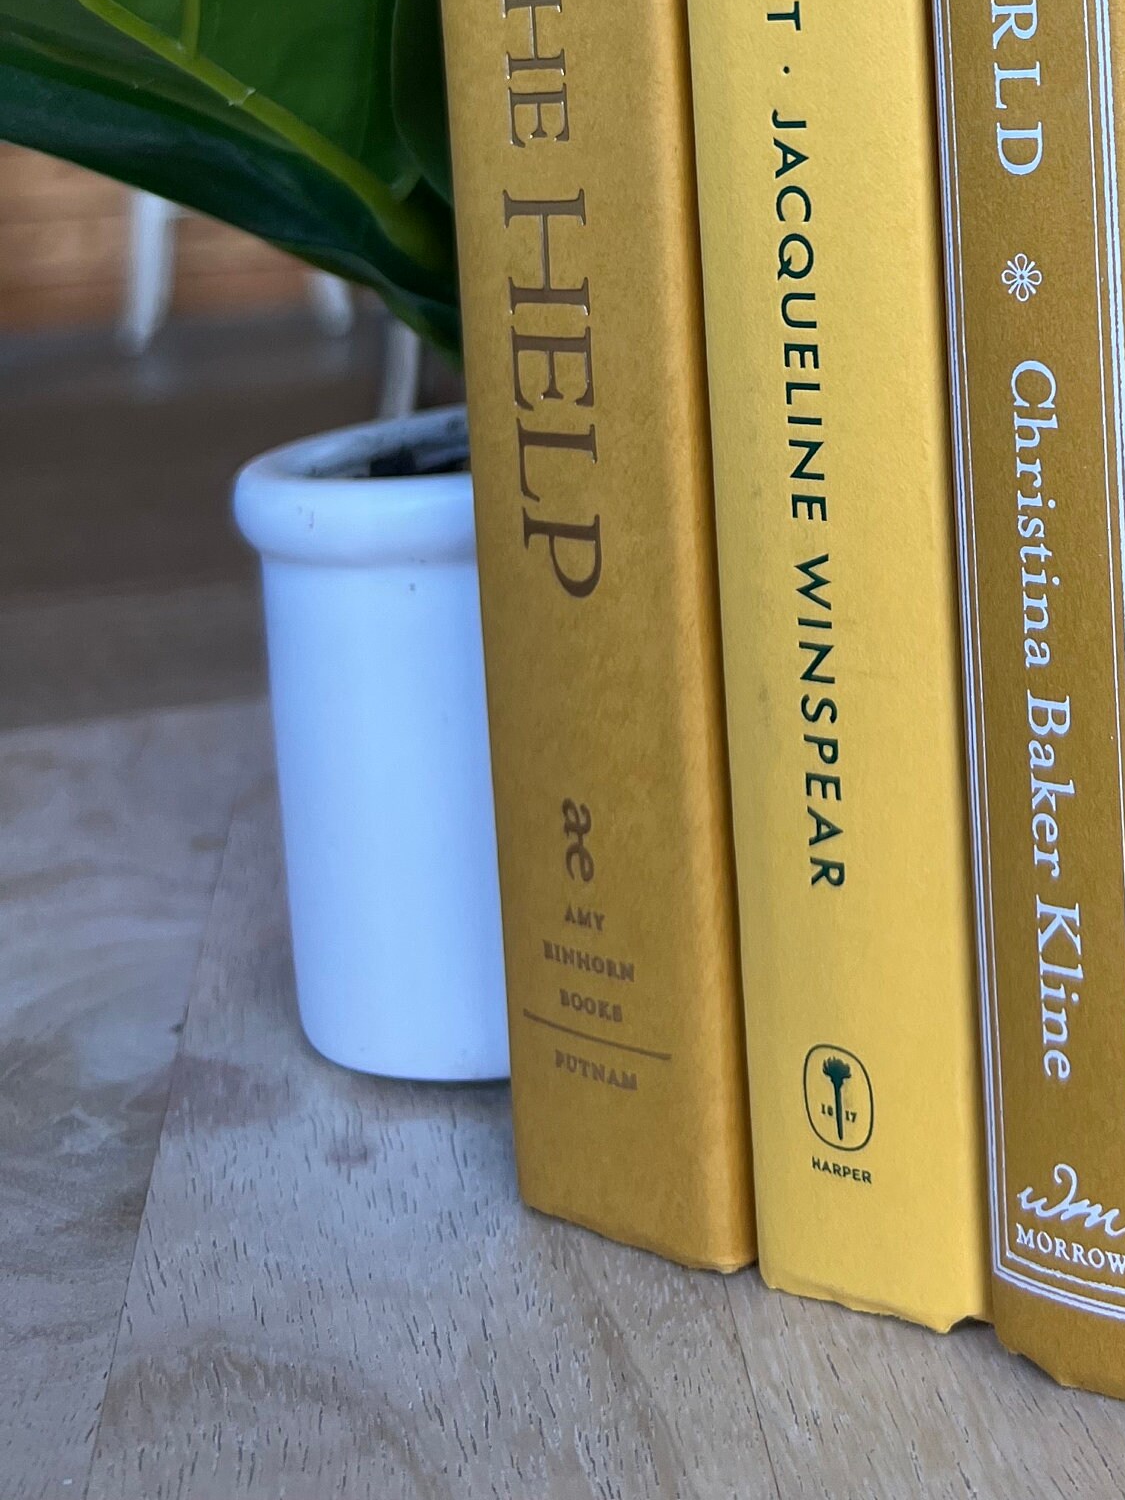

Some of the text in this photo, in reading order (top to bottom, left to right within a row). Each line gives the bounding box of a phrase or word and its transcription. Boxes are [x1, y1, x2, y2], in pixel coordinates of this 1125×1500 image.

[502, 188, 603, 599] HELP
[771, 108, 829, 523] JACQUELINE
[1010, 358, 1064, 669] Christina
[794, 552, 846, 889] WINSPEAR
[1026, 694, 1077, 879] Baker
[542, 938, 635, 983] EINHORN
[558, 987, 624, 1023] BOOKS
[564, 904, 606, 932] AMY
[1035, 893, 1085, 1082] Kline
[554, 1048, 638, 1092] PUTNAM
[811, 1155, 873, 1185] HARPER
